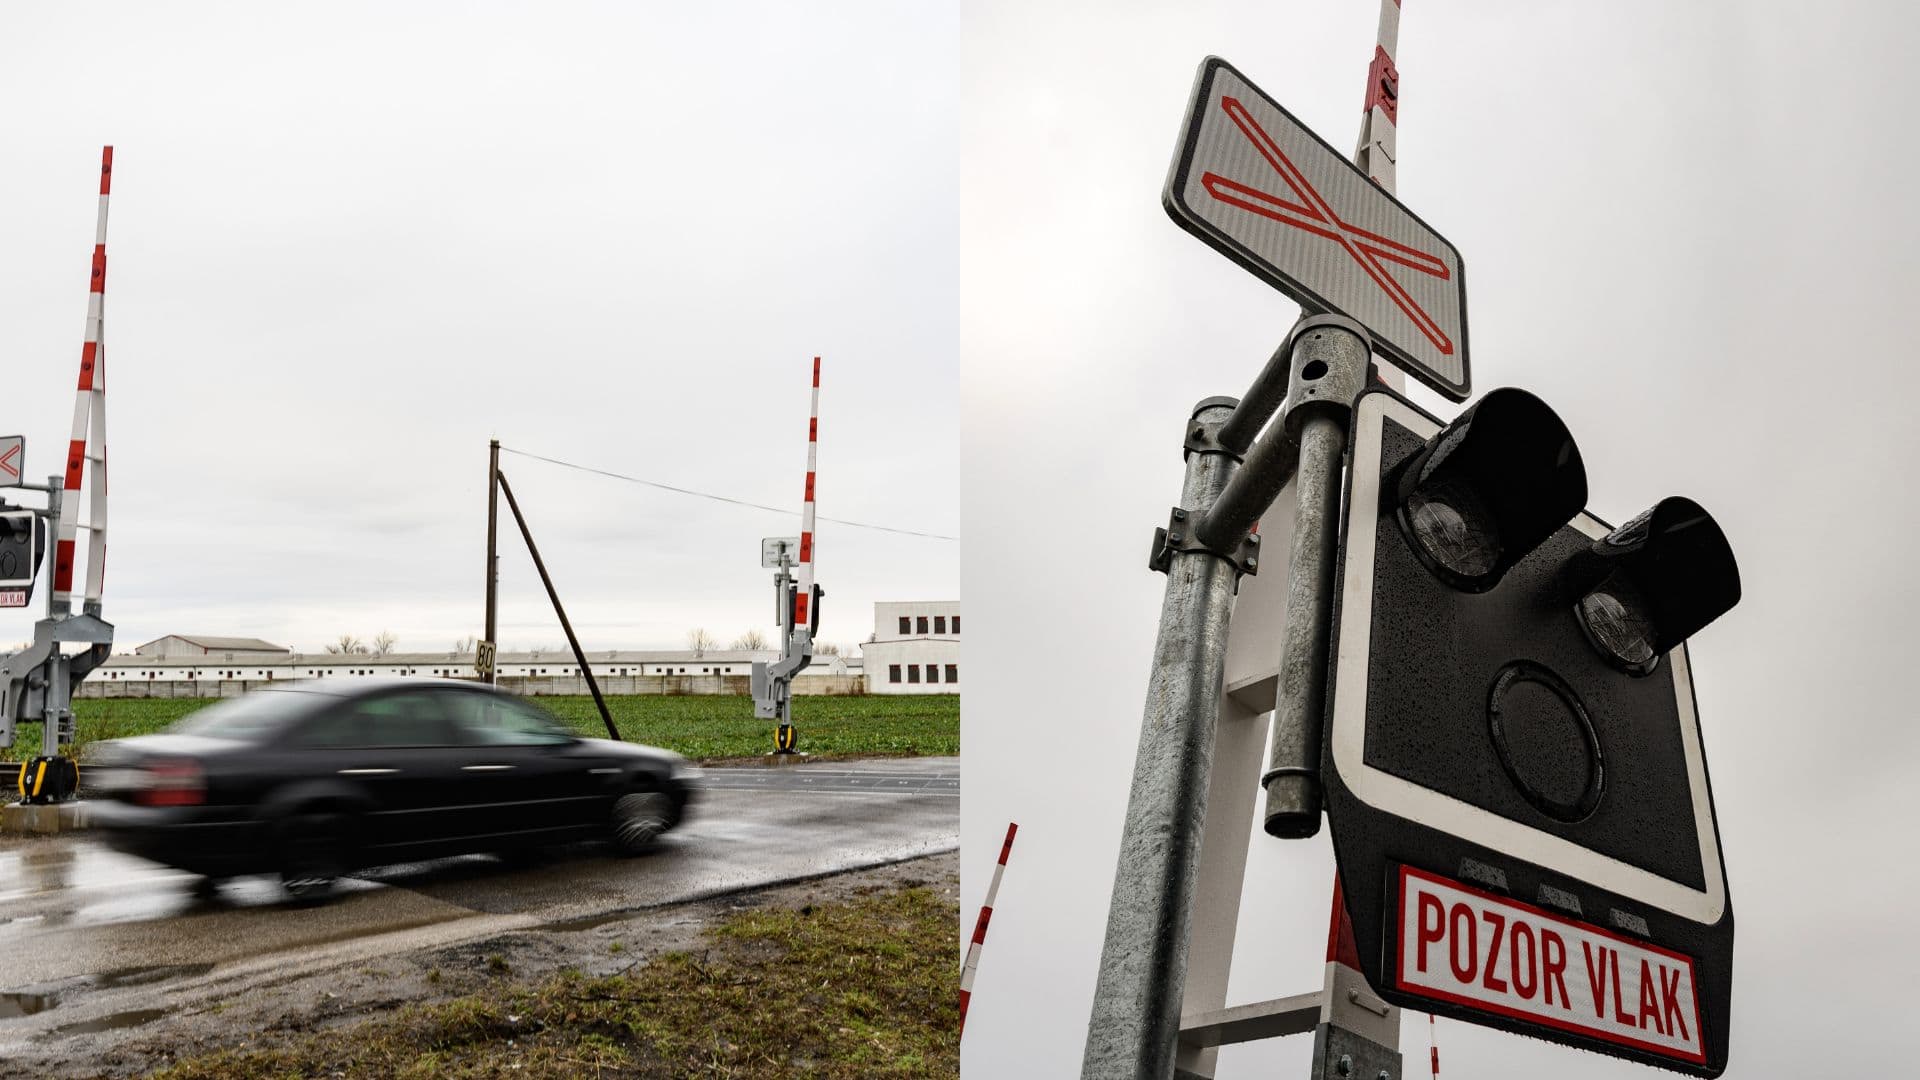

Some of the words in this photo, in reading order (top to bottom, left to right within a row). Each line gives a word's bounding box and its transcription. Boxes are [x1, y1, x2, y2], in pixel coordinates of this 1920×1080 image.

[477, 644, 493, 668] 80
[1417, 890, 1571, 1010] POZOR
[1582, 940, 1690, 1041] VLAK
